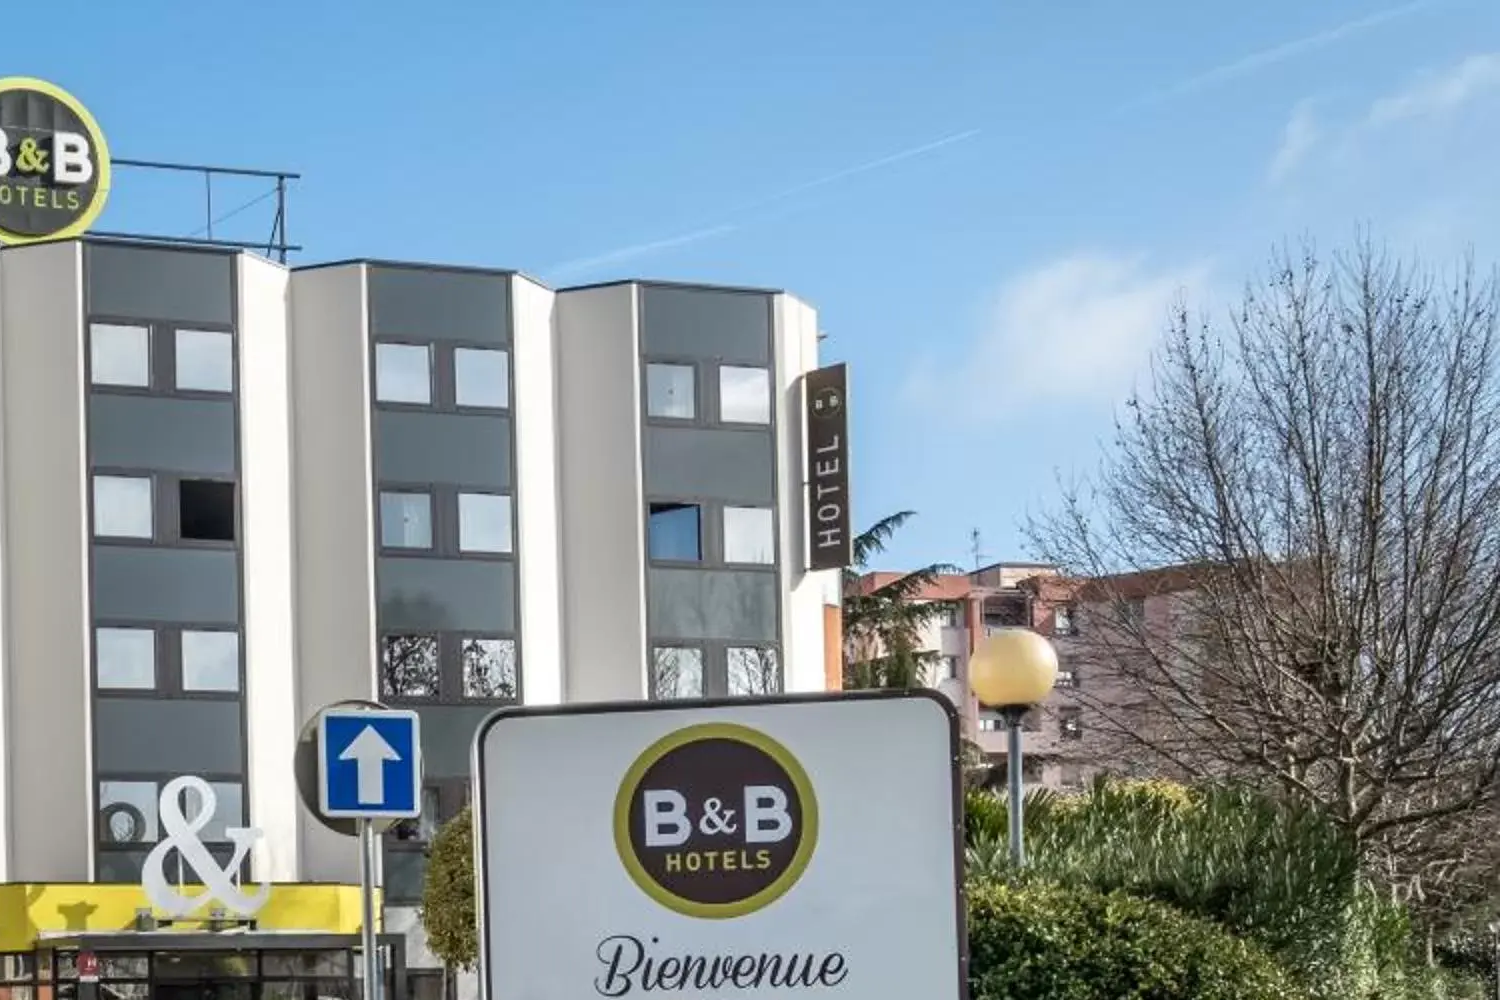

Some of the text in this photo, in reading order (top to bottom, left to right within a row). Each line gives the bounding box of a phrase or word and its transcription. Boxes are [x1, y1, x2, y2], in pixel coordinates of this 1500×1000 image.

[815, 434, 842, 549] HOTEL
[643, 785, 793, 847] B&B
[665, 849, 773, 872] HOTELS
[594, 935, 849, 998] Bienvenue
